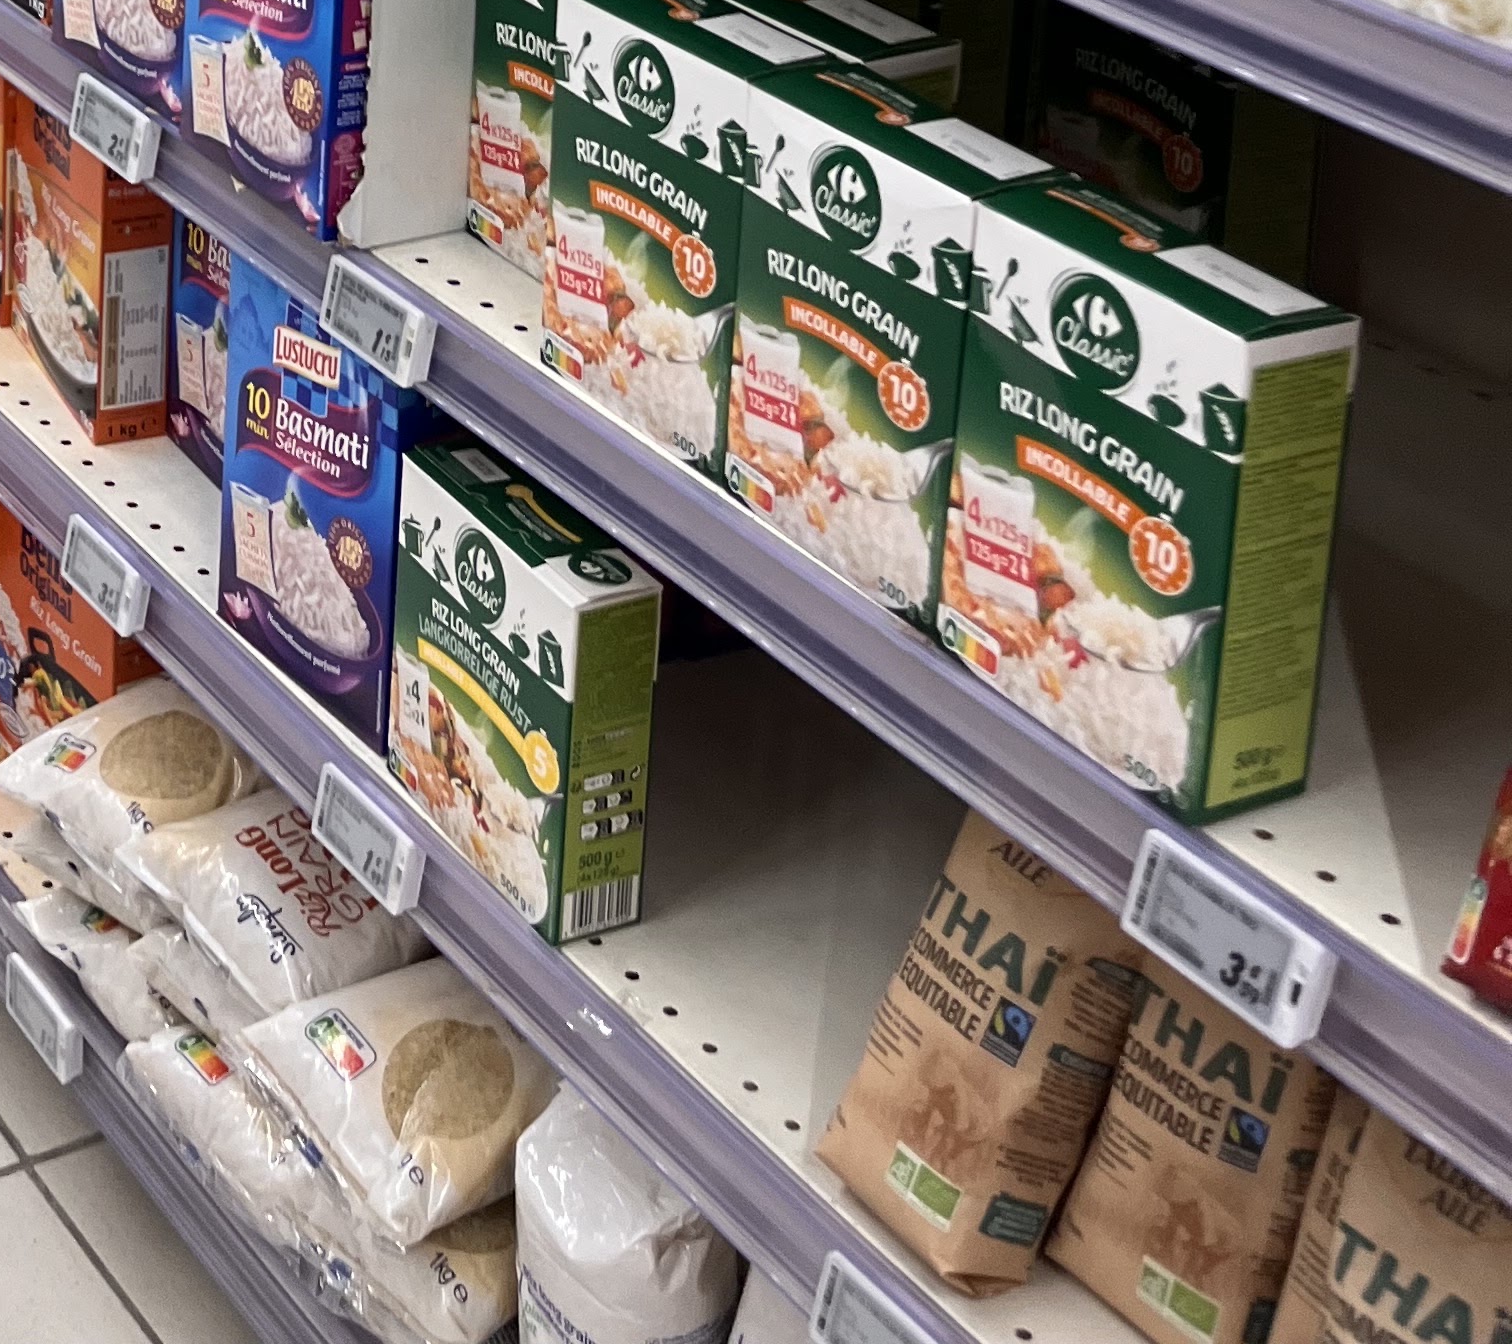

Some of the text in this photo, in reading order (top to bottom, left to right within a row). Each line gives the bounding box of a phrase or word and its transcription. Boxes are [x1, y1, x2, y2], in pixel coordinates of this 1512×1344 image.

[496, 22, 517, 48] RIZ
[575, 137, 708, 230] RIZ LONG GRAIN
[596, 186, 673, 241] INCOLLABLE
[683, 246, 705, 276] 10
[767, 248, 919, 357] RIZ LONG GRAIN
[790, 304, 878, 368] INCOLLABLE
[276, 329, 337, 380] Lustucru
[246, 382, 270, 420] 10
[246, 417, 269, 440] min
[890, 375, 917, 413] 10
[275, 431, 341, 479] Sélection
[276, 398, 369, 469] Basmati
[1000, 381, 1184, 512] RIZ LONG GRAIN
[1025, 445, 1133, 523] INCOLLABLE
[457, 559, 499, 615] Classic
[1144, 531, 1177, 572] 10
[418, 613, 532, 735] LANGKORRELIGE RIJST
[431, 597, 520, 696] RIZ LONG GRAIN
[913, 928, 995, 1006] COMMERCE
[925, 872, 1067, 1006] THAÏ
[899, 949, 981, 1040] ÉQUITABLE
[1124, 1035, 1224, 1121] COMMERCE
[1130, 975, 1295, 1113] THAÏ
